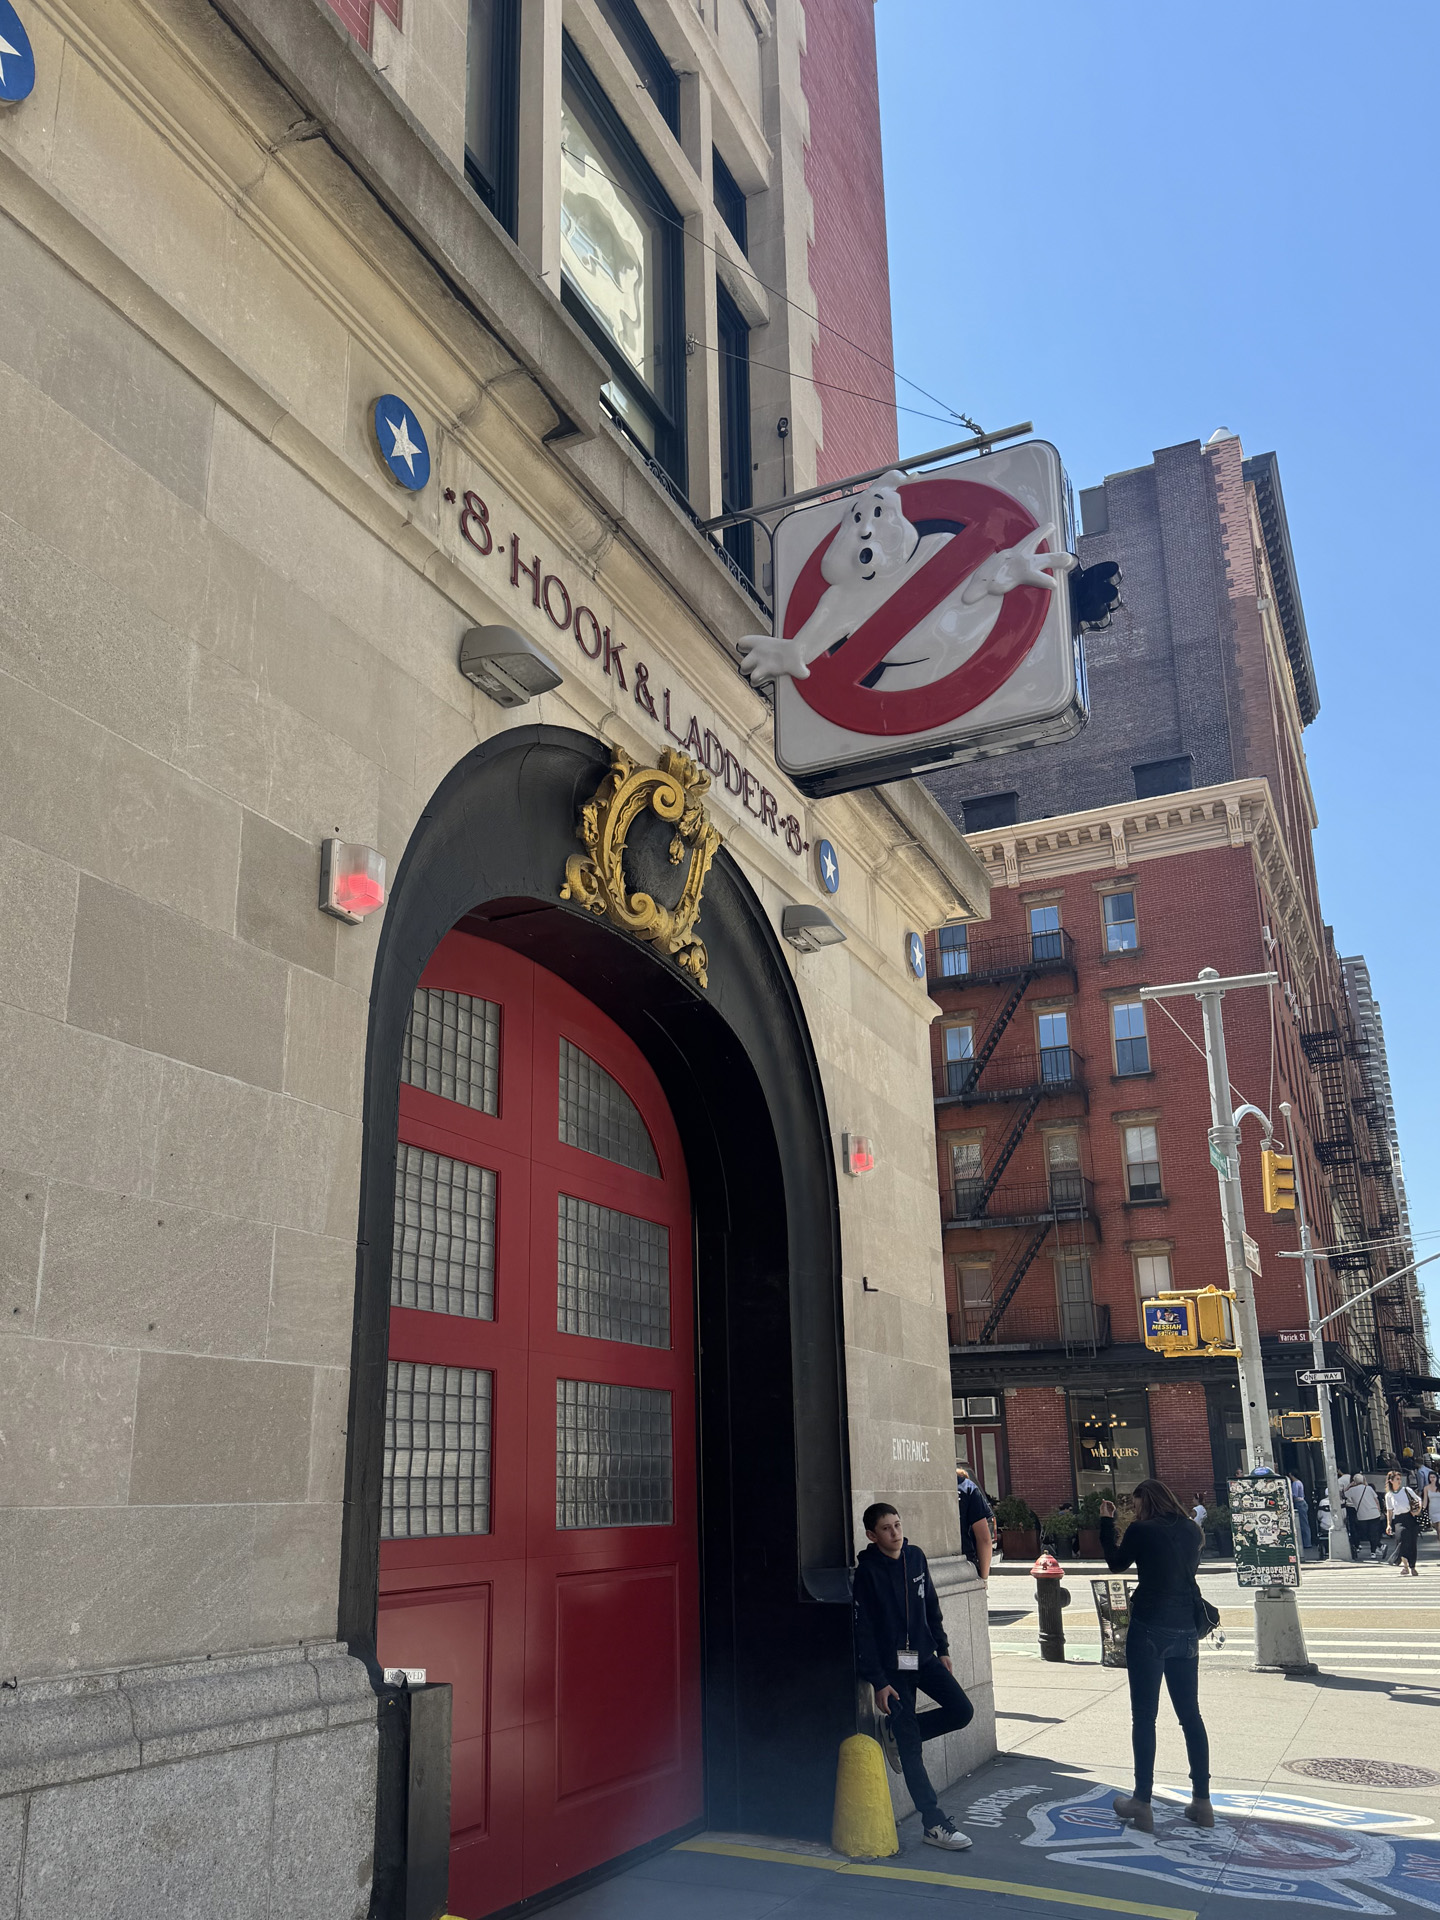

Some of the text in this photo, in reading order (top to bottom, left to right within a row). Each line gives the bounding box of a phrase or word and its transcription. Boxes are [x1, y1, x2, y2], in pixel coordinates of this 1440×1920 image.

[511, 533, 628, 692] HOOK
[635, 662, 660, 722] &
[663, 688, 778, 836] LADDER
[1280, 1333, 1306, 1341] Varick St
[892, 1438, 930, 1462] ENTRANCE
[962, 1798, 1015, 1828] LADDER
